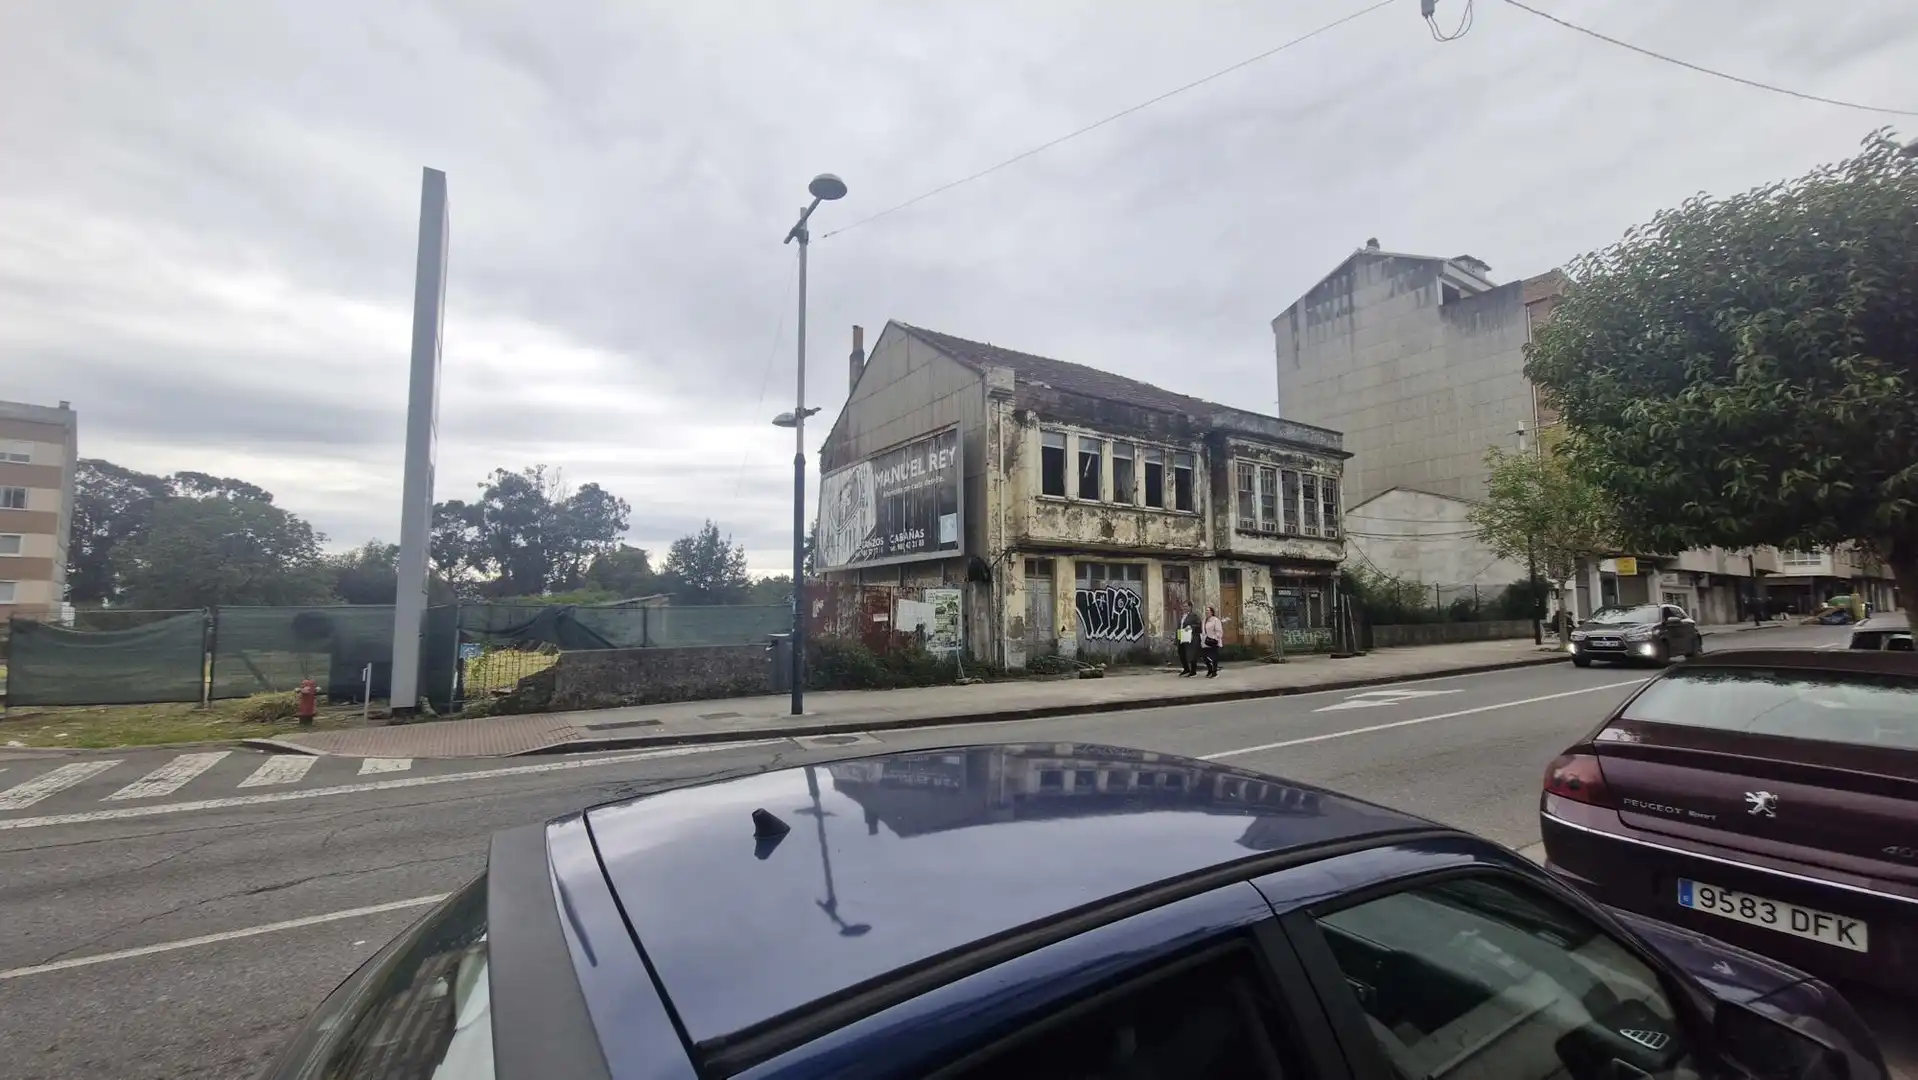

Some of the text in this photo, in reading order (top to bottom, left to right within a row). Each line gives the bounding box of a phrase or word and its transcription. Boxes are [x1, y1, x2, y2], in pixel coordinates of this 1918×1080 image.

[874, 457, 926, 489] MANUEL
[929, 446, 957, 472] REY
[889, 528, 925, 544] CABAÑAS
[1623, 798, 1683, 814] PEUGEOT
[1699, 887, 1858, 946] 9583 DFK
